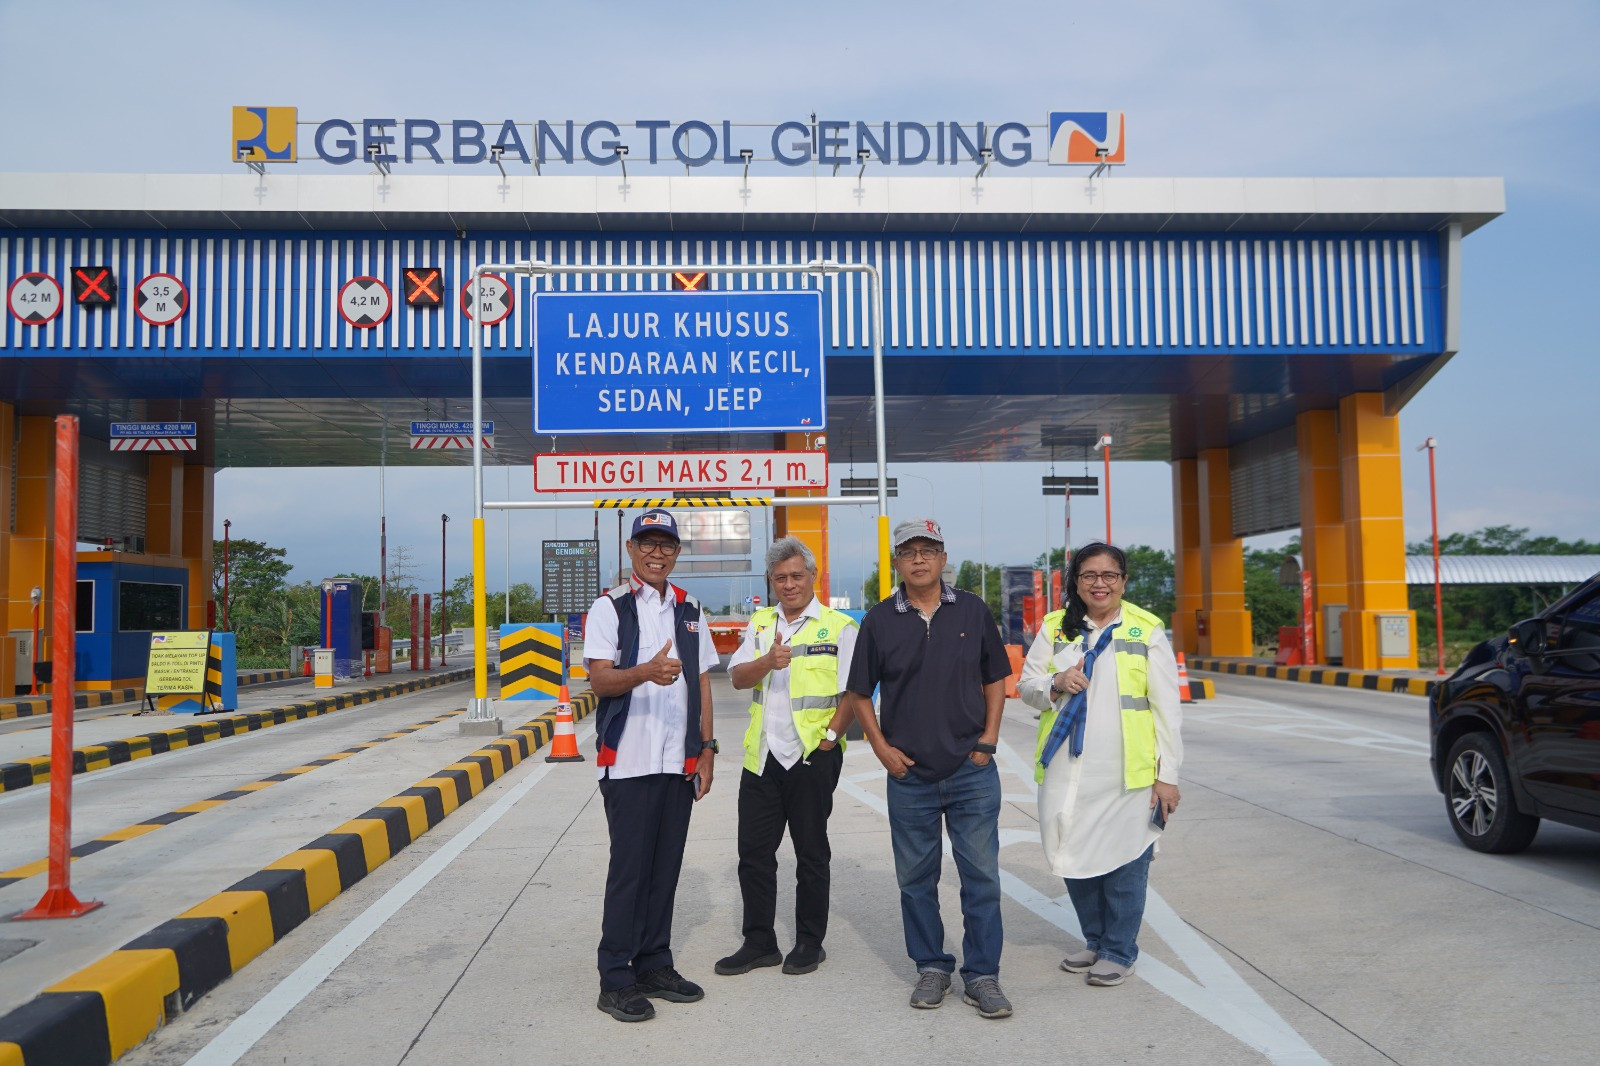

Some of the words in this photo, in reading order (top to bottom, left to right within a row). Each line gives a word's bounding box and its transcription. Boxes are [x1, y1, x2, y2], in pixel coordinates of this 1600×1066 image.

[314, 118, 621, 166] GERBANG
[635, 119, 742, 167] TOL
[771, 121, 1032, 167] GENDING
[152, 287, 170, 297] 3,5
[480, 287, 496, 298] 2,5
[20, 293, 37, 303] 4,2
[41, 293, 51, 302] M
[350, 296, 367, 307] 4,2
[370, 296, 380, 305] M
[156, 303, 166, 312] M
[483, 302, 492, 312] M
[568, 312, 660, 338] LAJUR
[674, 311, 790, 338] KHUSUS
[556, 351, 717, 375] KENDARAAN
[730, 350, 810, 378] KECIL,
[598, 388, 690, 416] SEDAN,
[704, 387, 762, 411] JEEP
[556, 460, 643, 484] TINGGI
[657, 459, 728, 483] MAKS
[740, 458, 772, 485] 2,1
[786, 462, 807, 481] m
